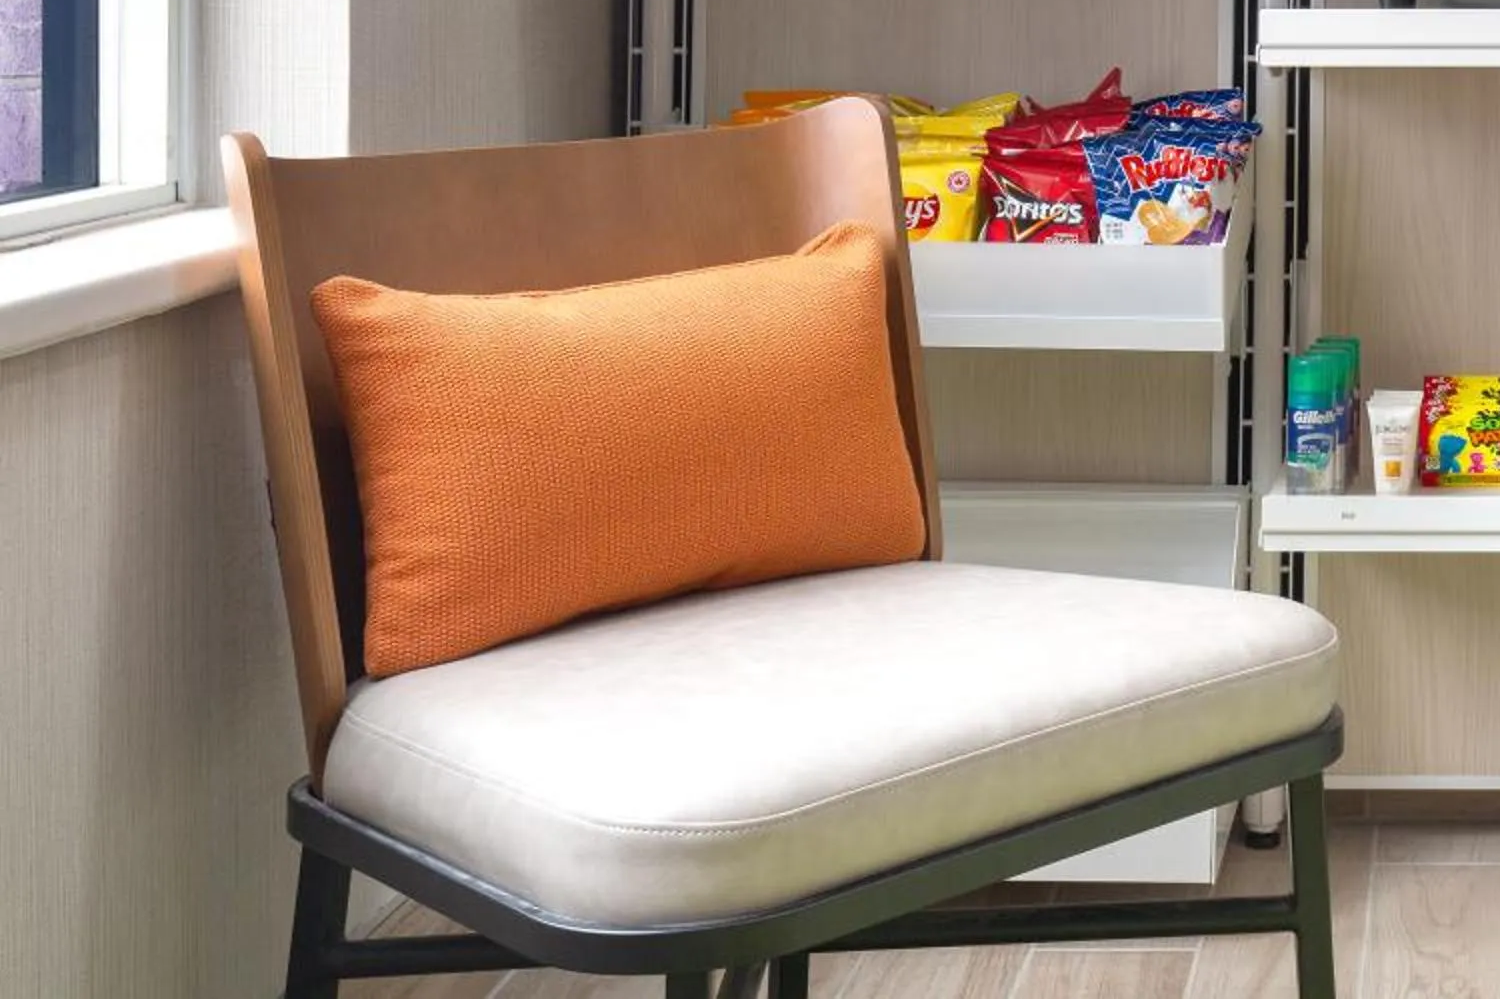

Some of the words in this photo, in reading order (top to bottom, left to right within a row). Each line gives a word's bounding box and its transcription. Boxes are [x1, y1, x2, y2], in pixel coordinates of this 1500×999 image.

[1119, 145, 1229, 193] Ruffles
[903, 196, 938, 230] y's
[993, 196, 1085, 226] Doritos
[1293, 411, 1336, 425] Gillette
